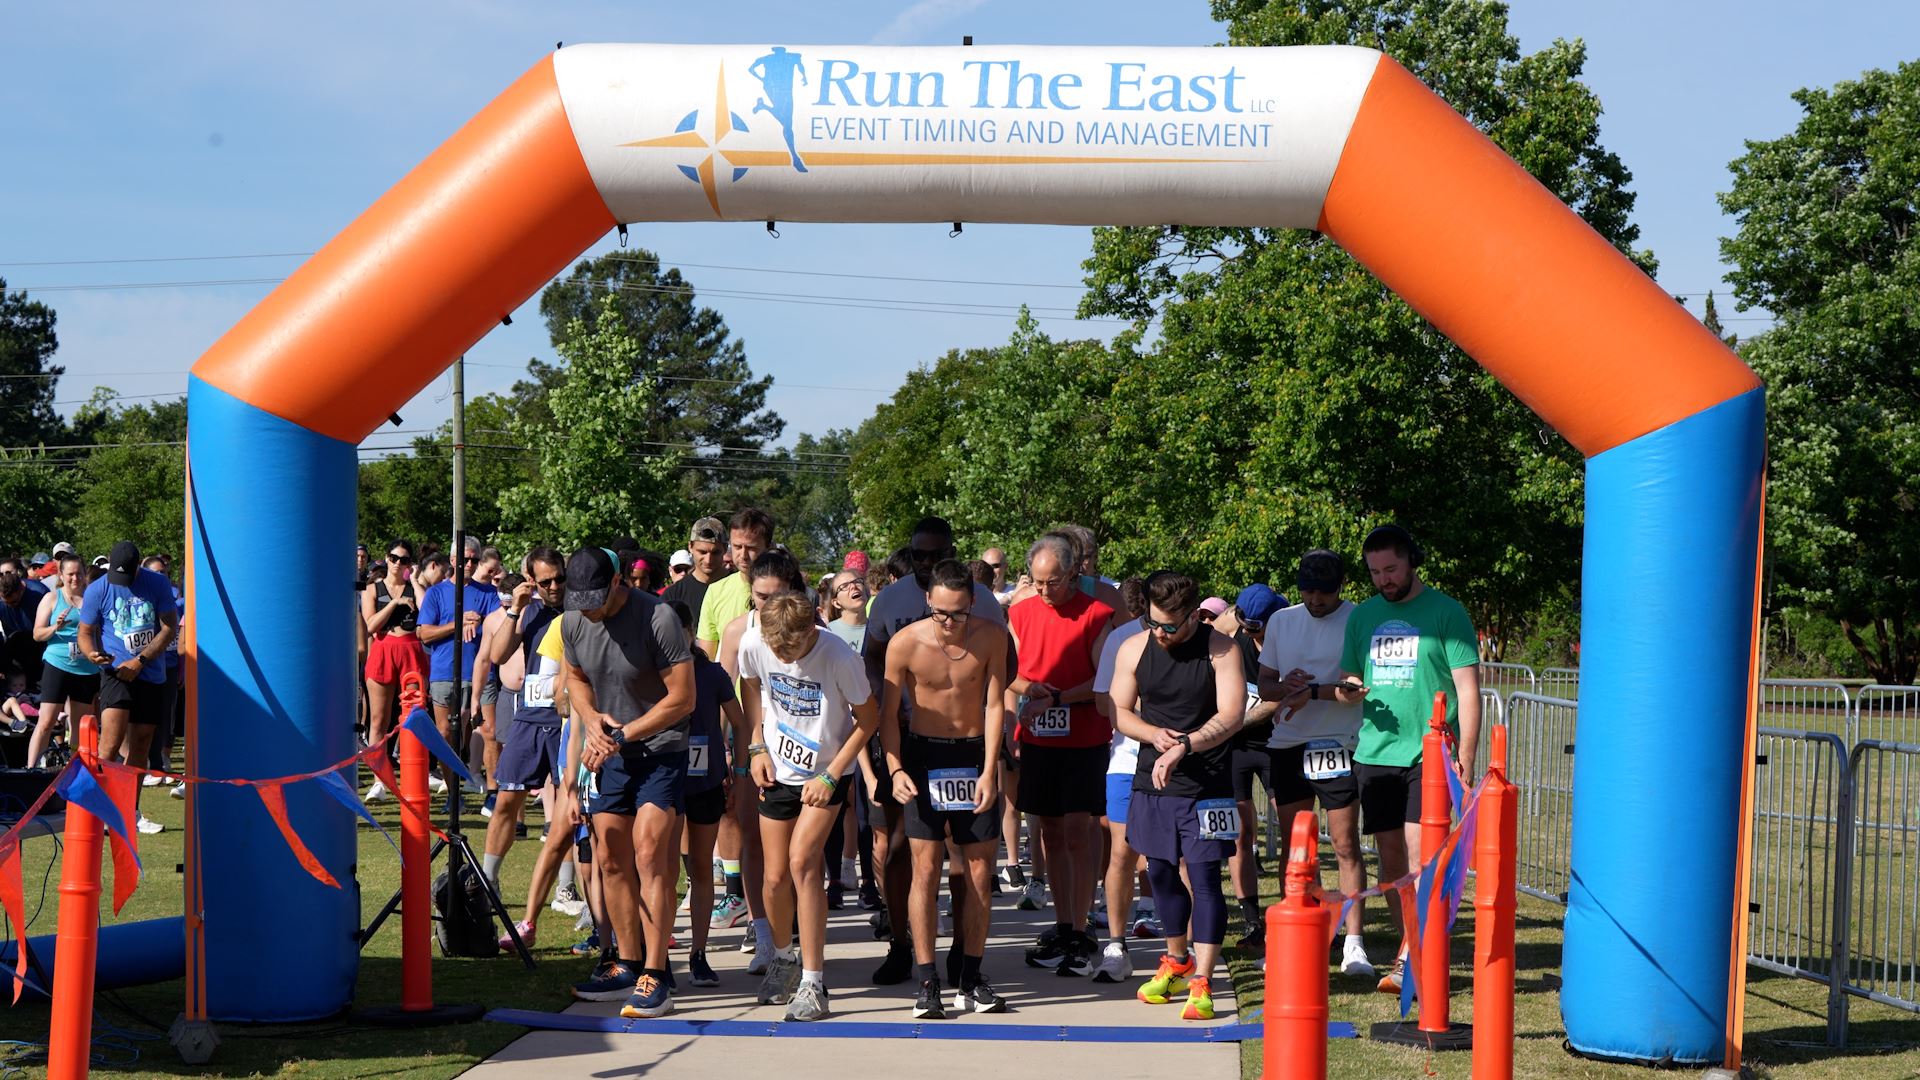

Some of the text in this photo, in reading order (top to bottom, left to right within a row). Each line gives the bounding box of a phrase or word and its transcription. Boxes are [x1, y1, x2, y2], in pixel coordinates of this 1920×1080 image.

[811, 60, 1275, 113] Run The East LLC
[811, 116, 1273, 148] EVENT TIMING AND MANAGEMENT
[127, 630, 153, 650] 1920
[1375, 637, 1415, 659] 1931
[778, 735, 814, 770] 1934
[1306, 749, 1347, 773] 1781
[935, 780, 976, 803] 1060
